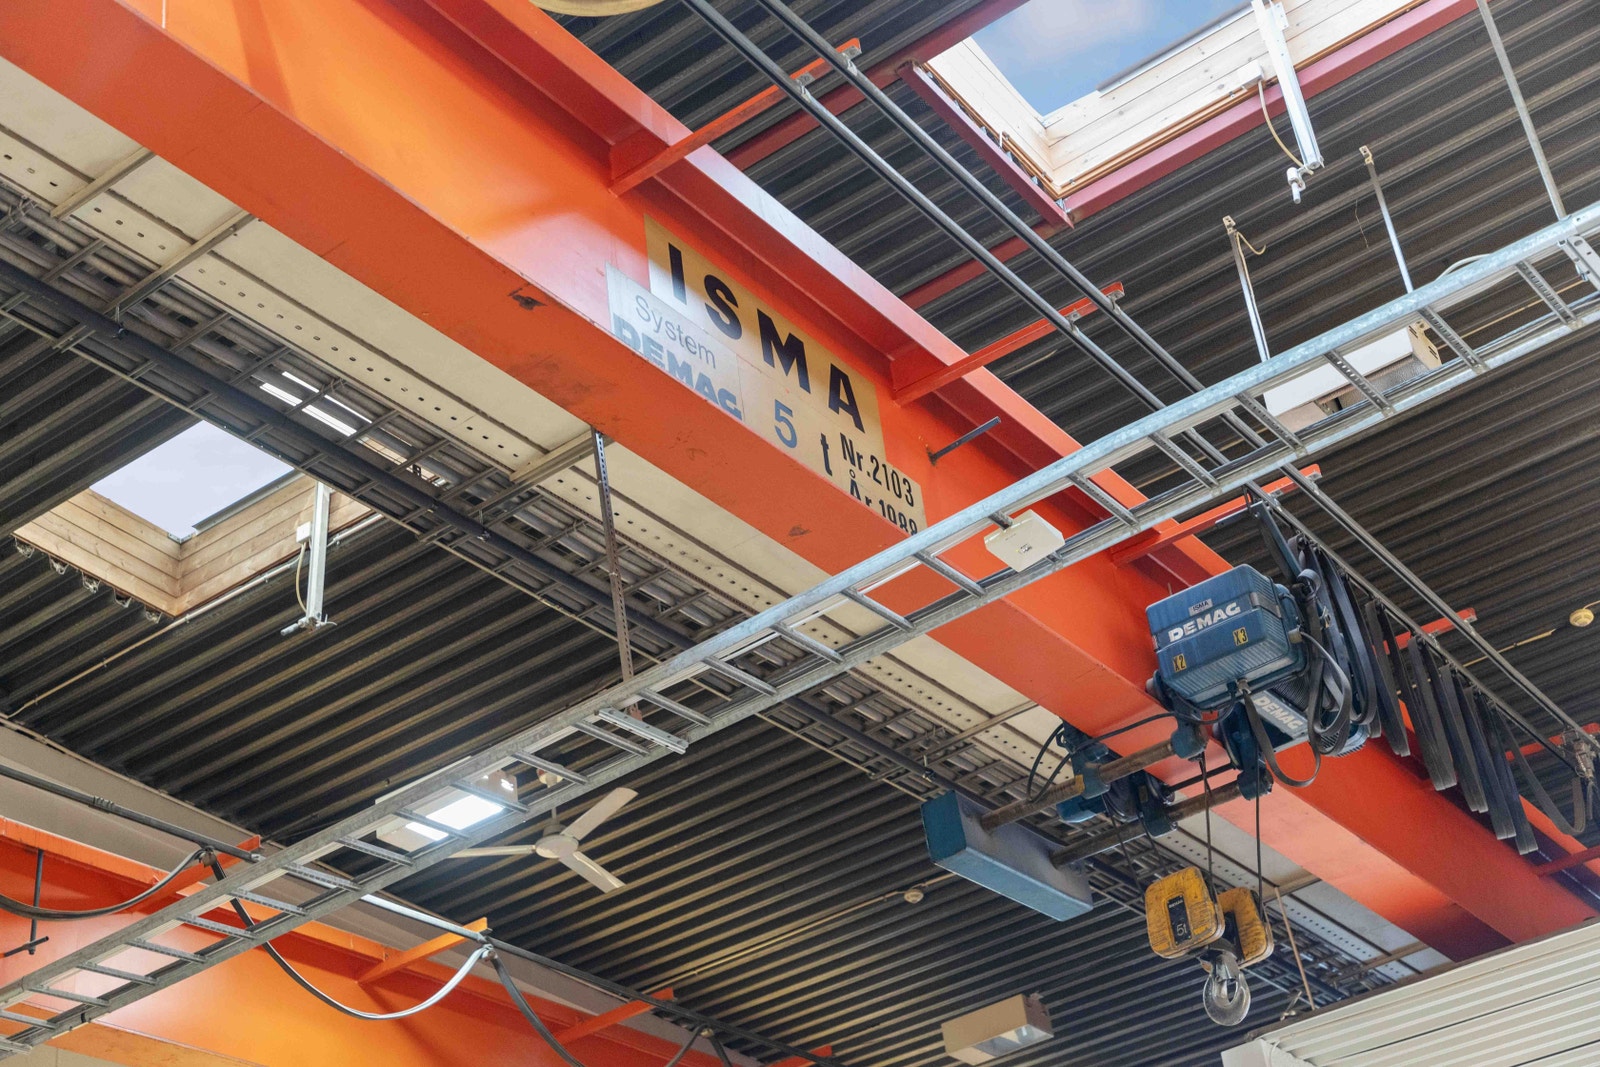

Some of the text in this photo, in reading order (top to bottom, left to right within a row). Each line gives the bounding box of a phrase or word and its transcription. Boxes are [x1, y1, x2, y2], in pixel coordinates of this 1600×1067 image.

[635, 295, 716, 369] System
[668, 243, 866, 434] ISMA
[774, 399, 833, 477] 5 t
[1168, 602, 1241, 642] DEMAG
[1253, 696, 1303, 729] DEMAG
